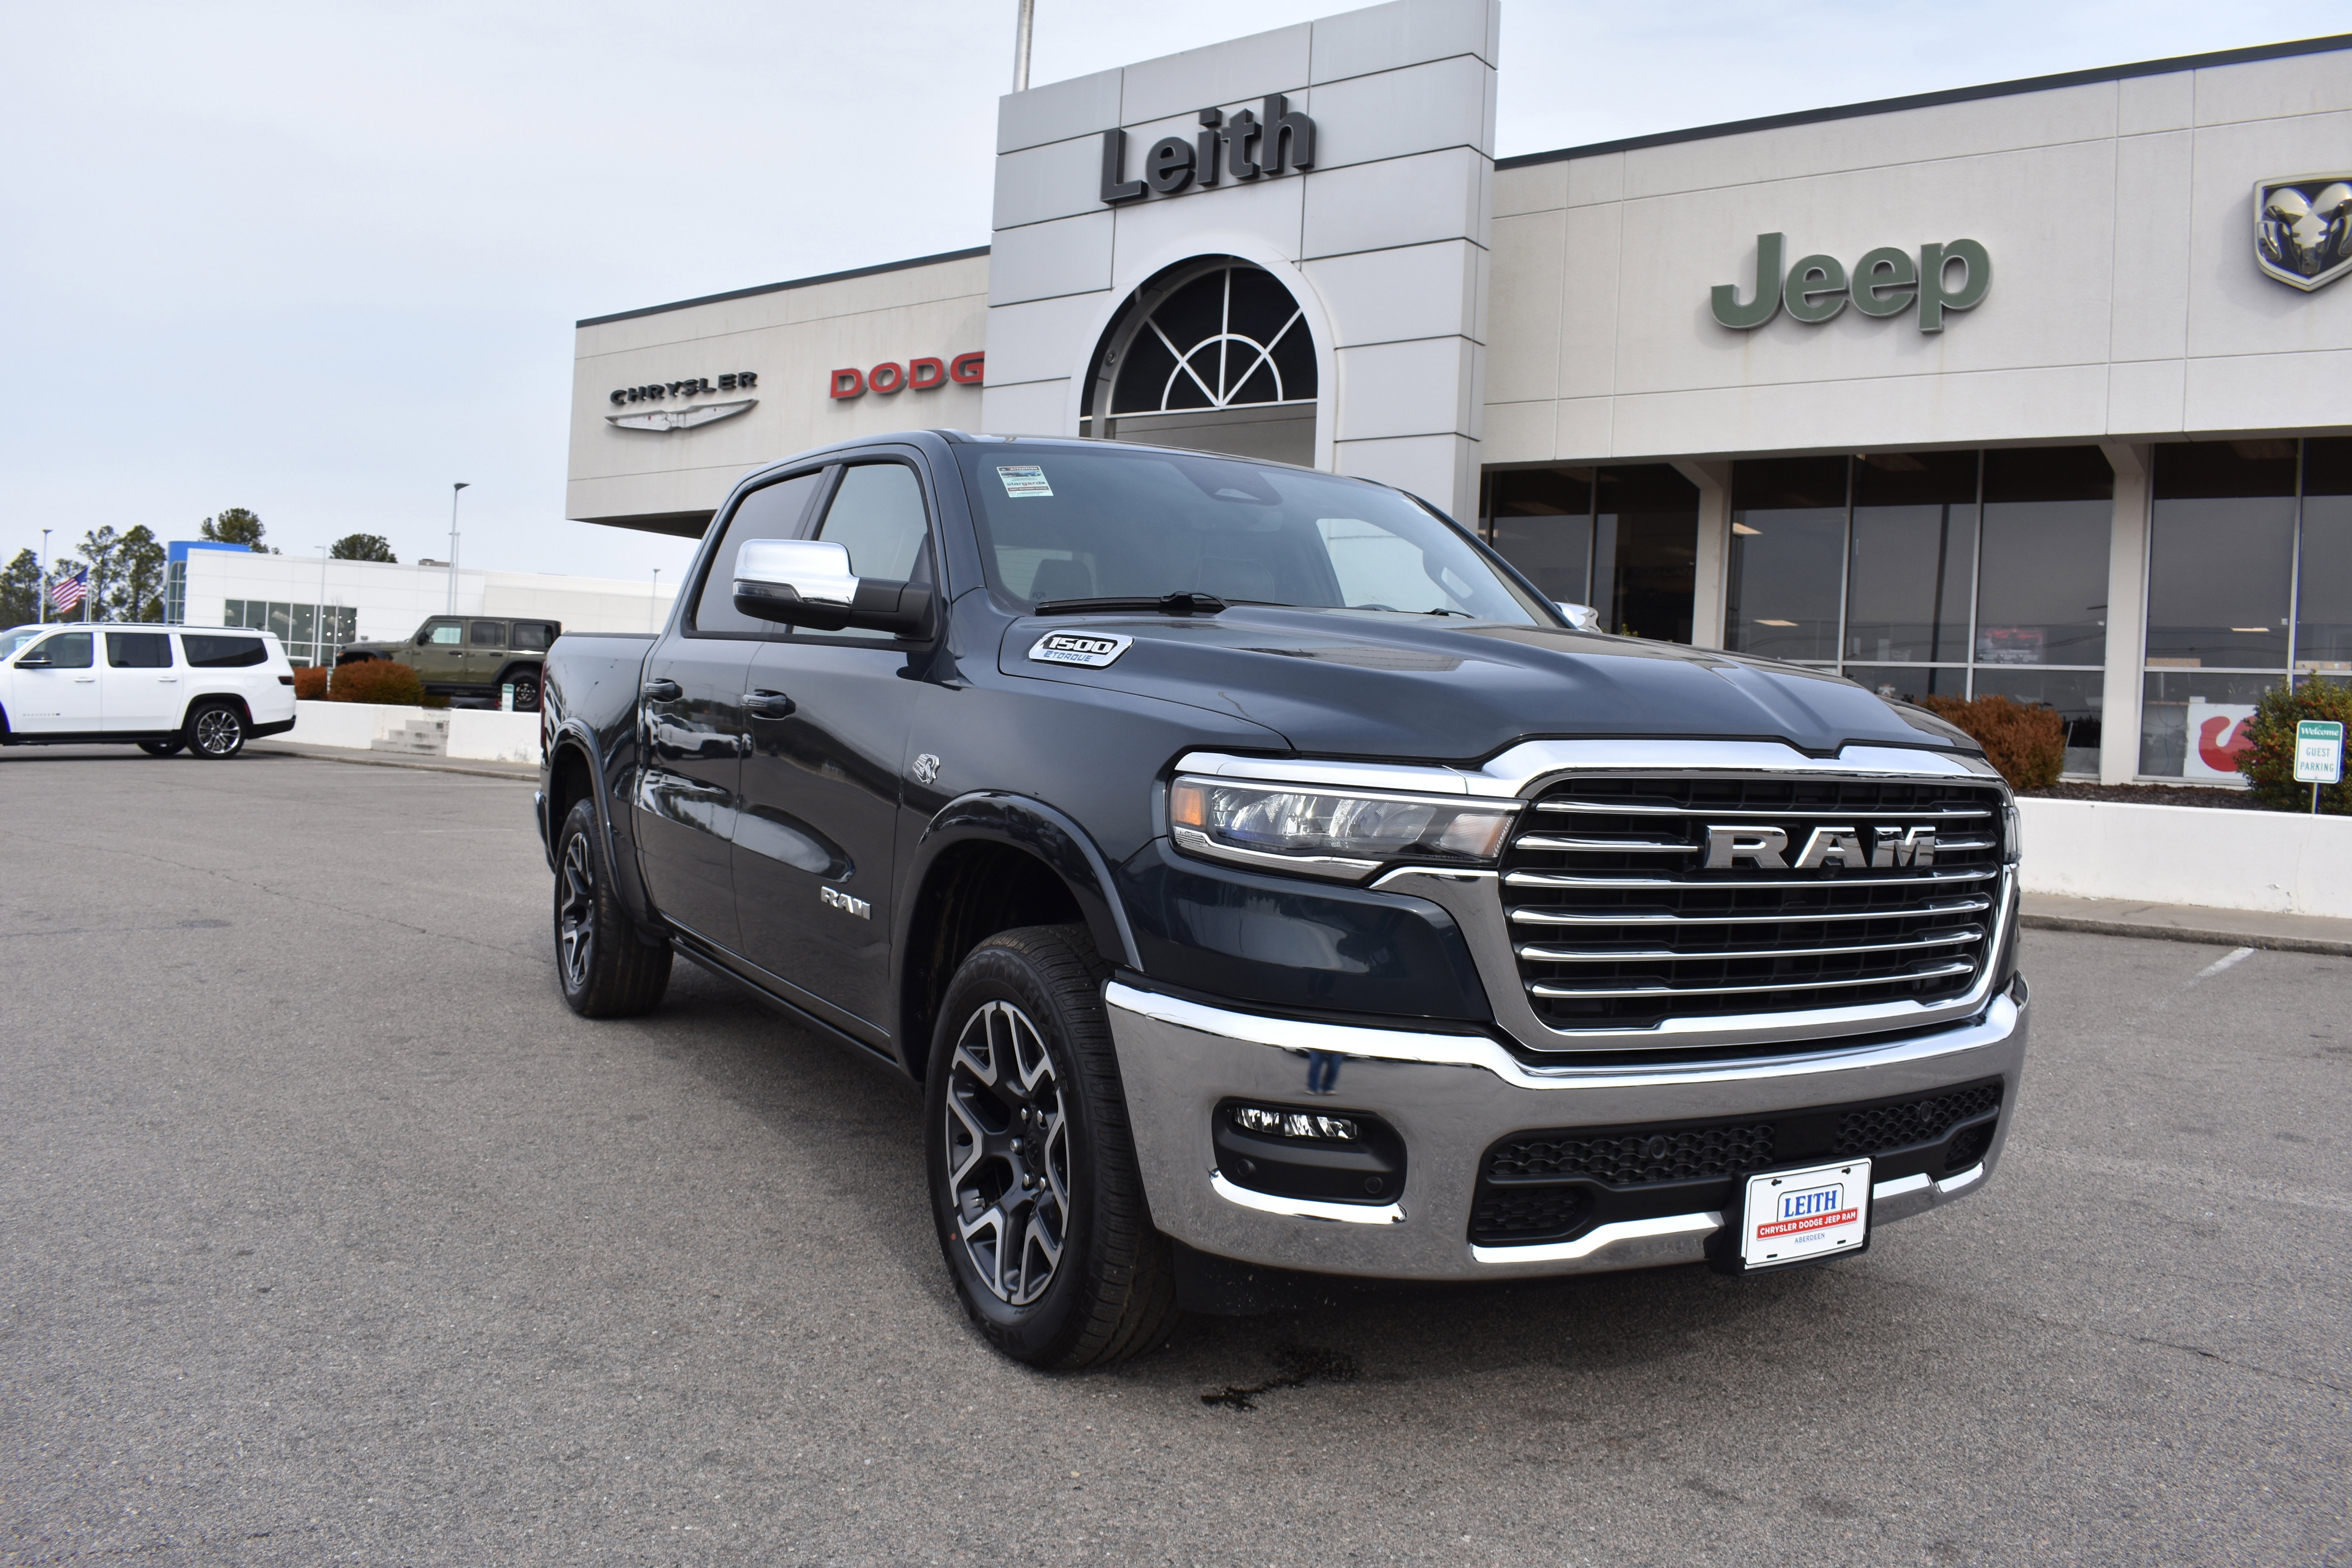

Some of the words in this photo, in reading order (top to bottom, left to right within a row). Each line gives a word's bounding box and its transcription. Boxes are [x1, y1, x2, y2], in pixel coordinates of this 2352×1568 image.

[1100, 94, 1316, 204] Leith
[1711, 232, 1992, 333] Jeep
[610, 371, 757, 405] CHRYSLER
[830, 351, 985, 399] DODG
[1049, 637, 1114, 653] 1500
[2301, 727, 2339, 736] Welcome
[2306, 748, 2330, 757] GUEST
[2300, 762, 2334, 772] PARKING
[1704, 825, 1936, 868] RAM
[821, 886, 871, 920] RAM
[1784, 1190, 1837, 1218] LEITH
[1760, 1221, 1797, 1236] CHRYSLER
[1799, 1218, 1823, 1231] DODGE
[1824, 1214, 1840, 1225] JEEP
[1842, 1212, 1856, 1221] RAM
[1795, 1233, 1825, 1244] ABERDEEN
